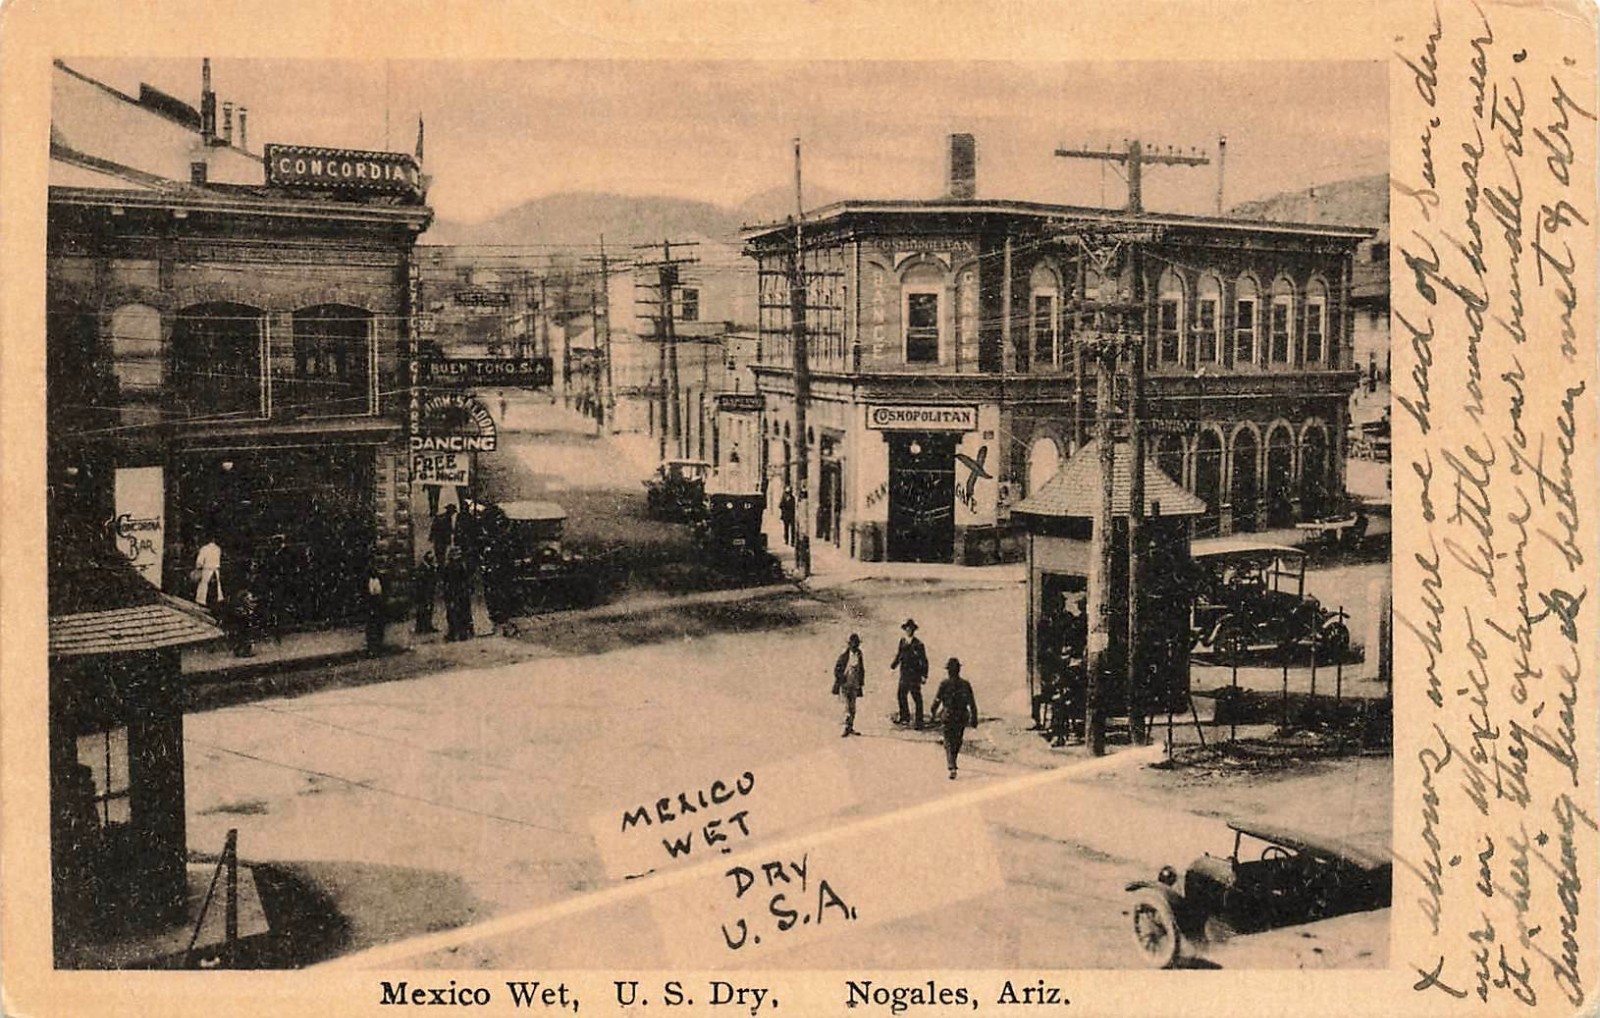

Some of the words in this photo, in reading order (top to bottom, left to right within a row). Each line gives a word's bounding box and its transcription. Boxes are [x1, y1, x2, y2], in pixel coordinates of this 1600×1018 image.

[278, 155, 405, 183] CONCORDIA
[874, 238, 974, 253] COSMOPOLITAN
[1393, 317, 1435, 435] had
[873, 408, 971, 425] COSMOPOLITAN
[410, 436, 495, 451] DANCING
[413, 454, 457, 471] FREE
[1515, 381, 1585, 572] between
[1443, 433, 1496, 597] little
[127, 537, 157, 561] BAR
[1395, 540, 1444, 708] where
[621, 770, 755, 833] MEXICO
[662, 810, 751, 859] WET
[725, 853, 809, 898] DRY
